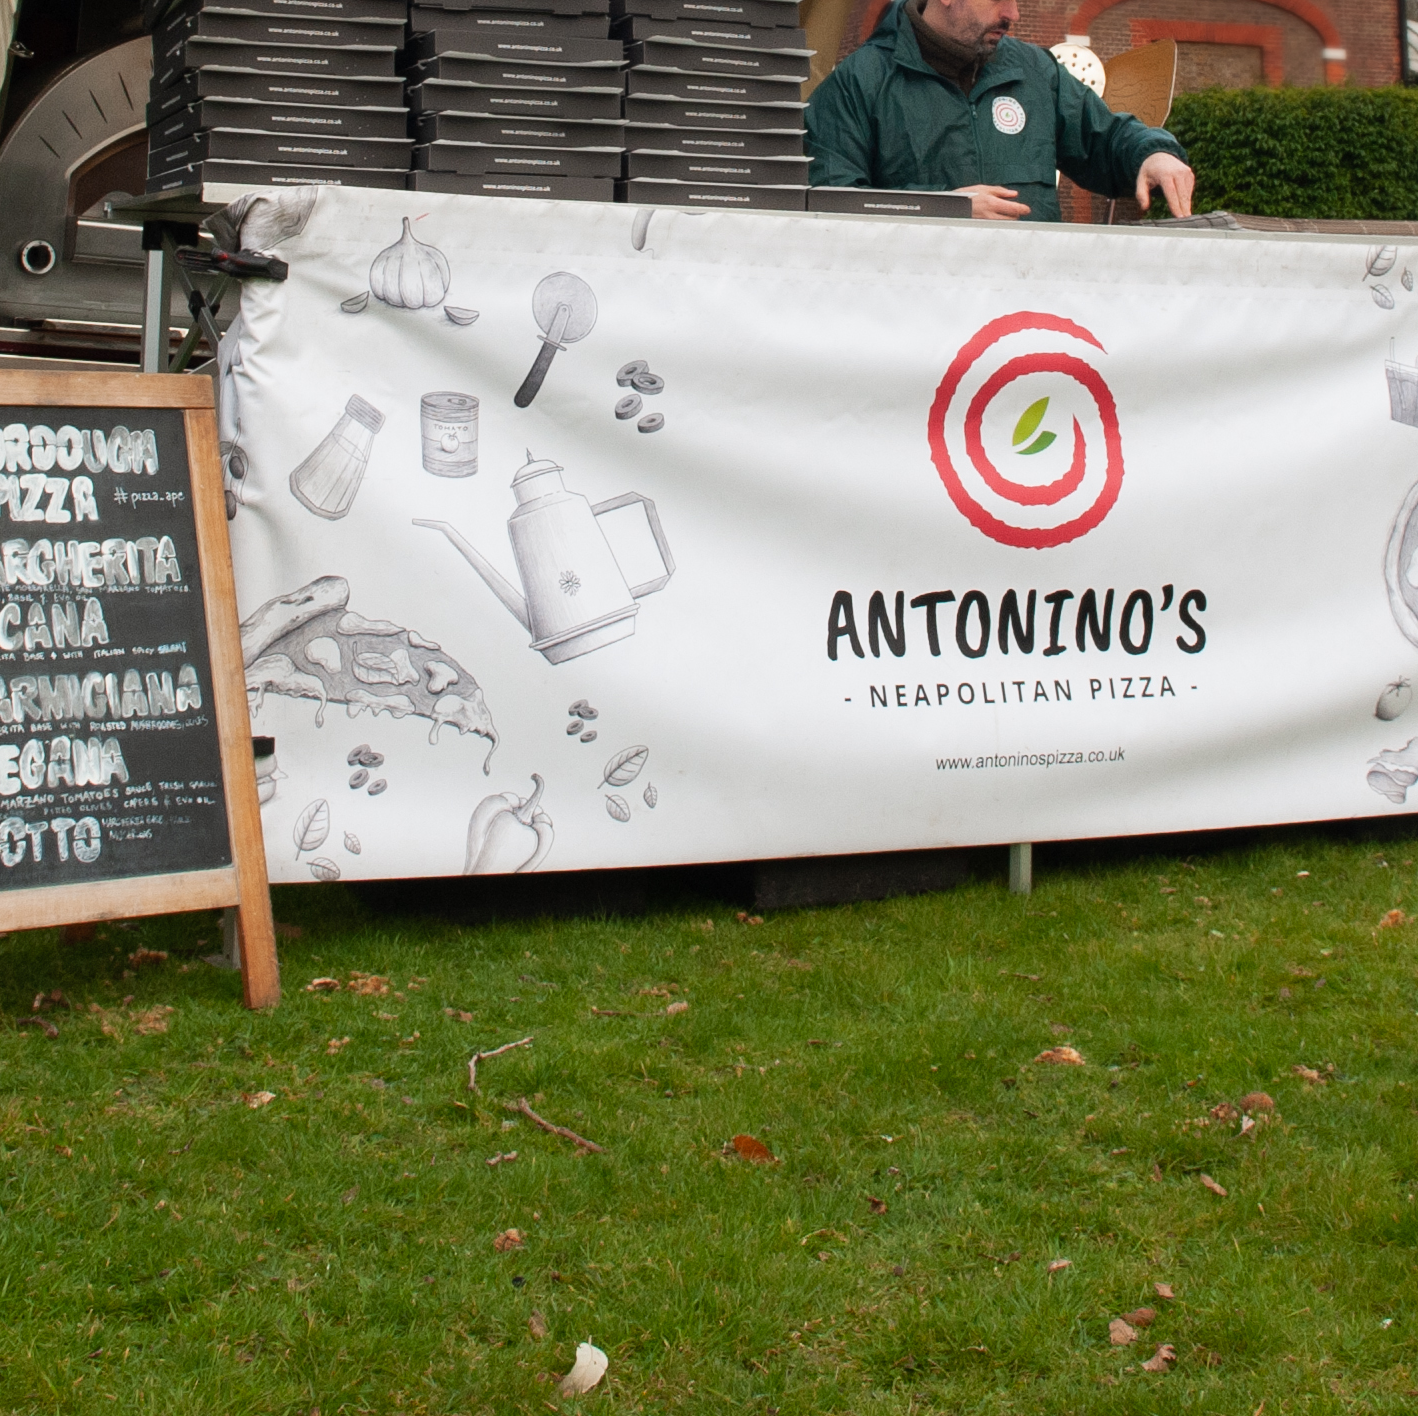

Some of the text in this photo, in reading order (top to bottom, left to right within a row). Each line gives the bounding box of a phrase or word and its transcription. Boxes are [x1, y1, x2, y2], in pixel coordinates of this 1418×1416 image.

[433, 423, 469, 432] TOMATO
[826, 584, 1208, 661] ANTONINO'S
[870, 675, 1176, 709] NEAPOLITAN PIZZA
[30, 722, 52, 732] BASE
[935, 746, 1126, 771] www.antoninospizza.co.uk
[0, 794, 55, 810] MARZANO
[60, 788, 119, 804] TOMATOES
